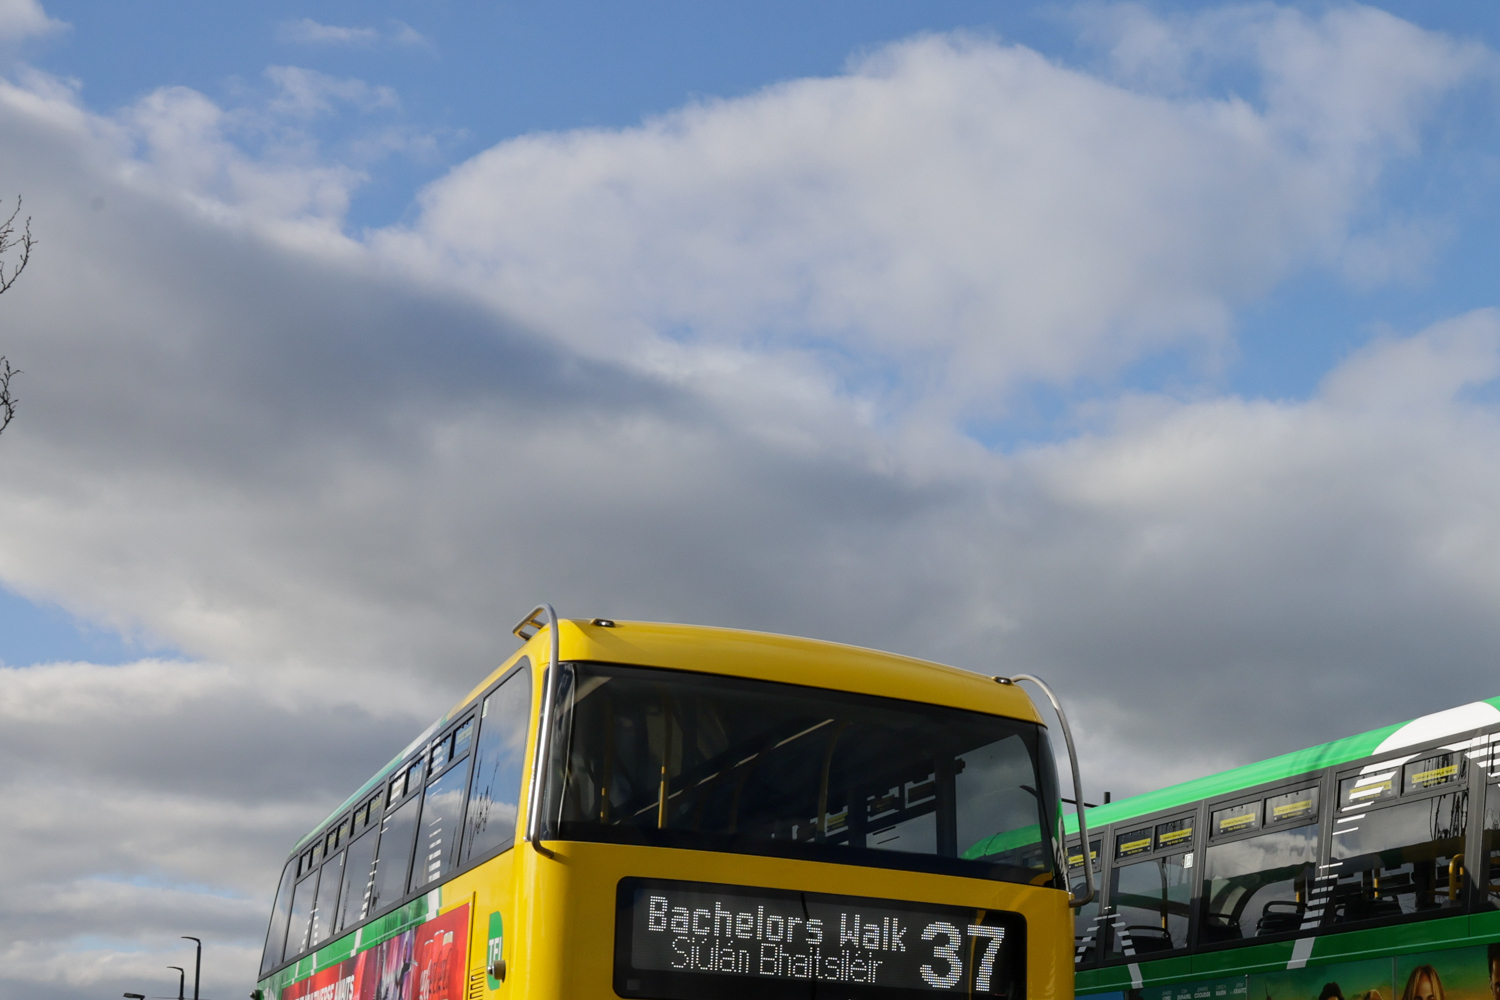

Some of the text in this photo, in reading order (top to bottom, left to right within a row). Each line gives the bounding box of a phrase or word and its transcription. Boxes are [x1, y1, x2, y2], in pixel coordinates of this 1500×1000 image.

[648, 896, 907, 952] Bachelors Walk
[488, 936, 503, 967] TFI
[671, 936, 750, 973] Siúlán
[919, 921, 1005, 992] 37
